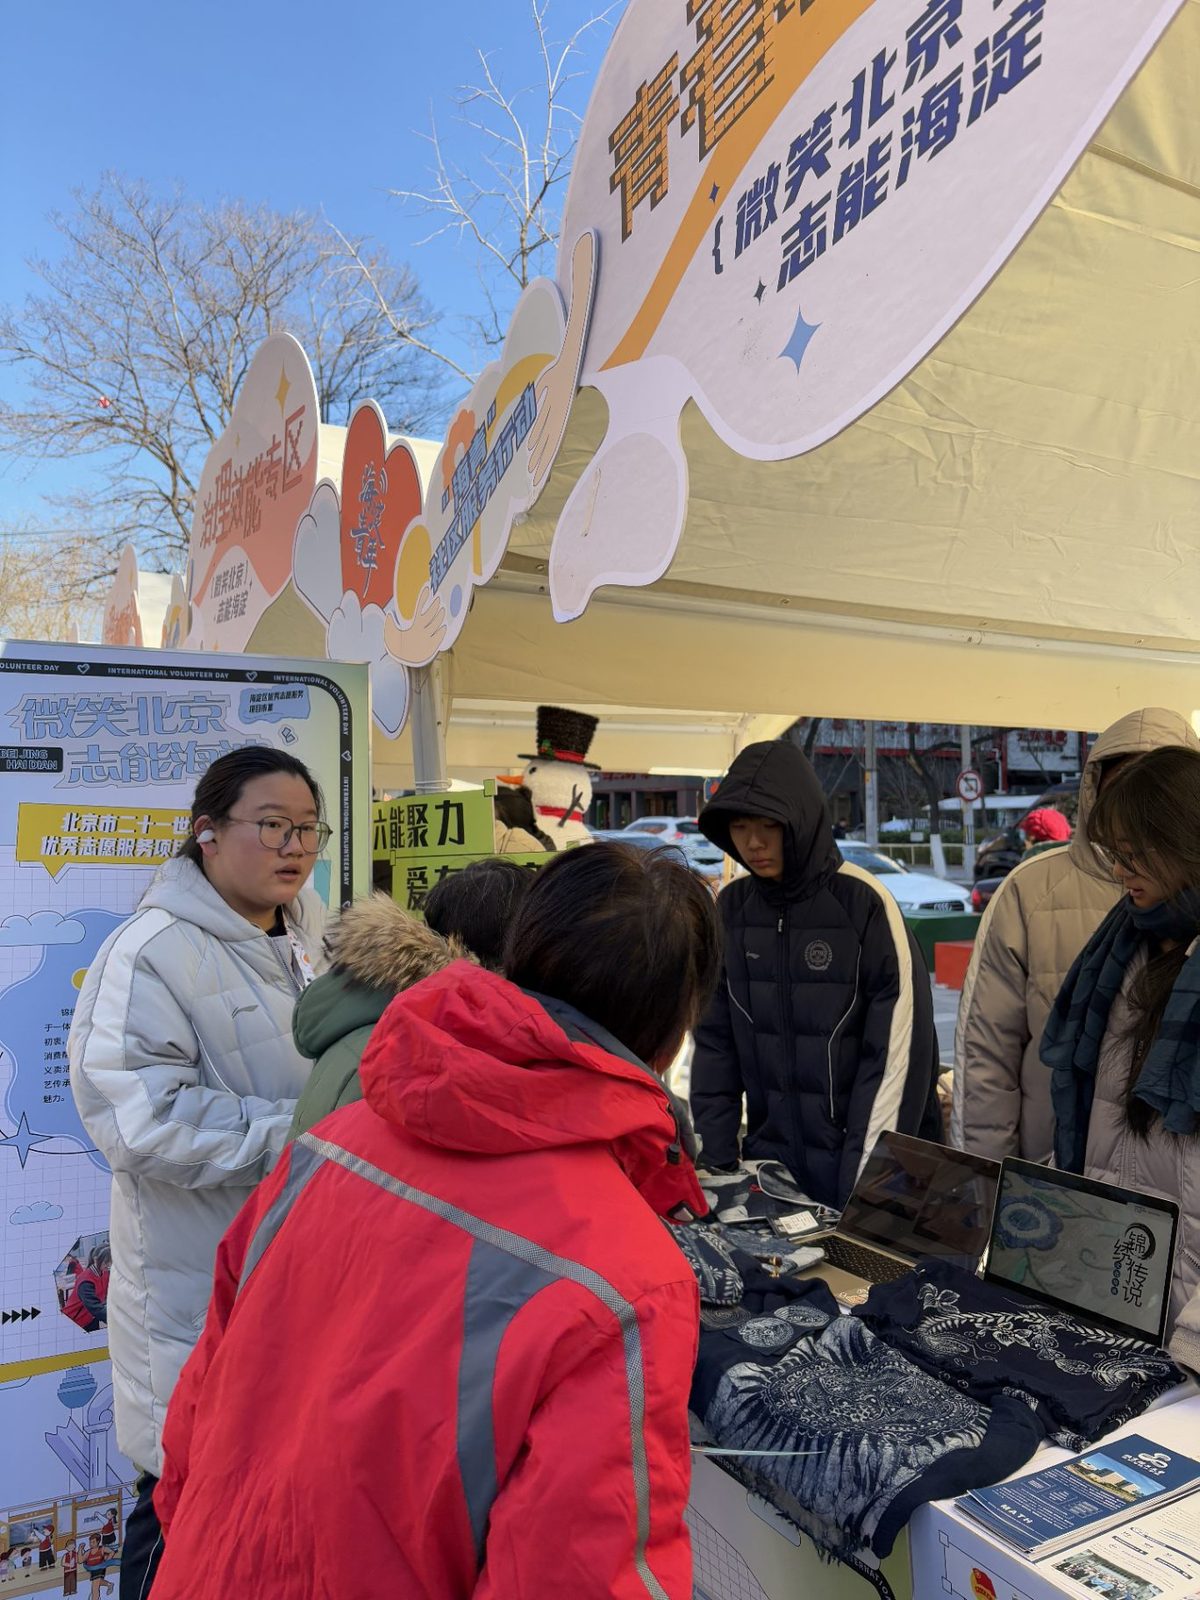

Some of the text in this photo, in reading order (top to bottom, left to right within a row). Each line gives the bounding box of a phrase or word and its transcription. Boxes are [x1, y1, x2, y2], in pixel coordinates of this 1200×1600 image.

[776, 0, 1048, 293] 志能海淀
[200, 405, 306, 549] 治理效能专区
[430, 382, 538, 595] 社区服务行动
[107, 667, 168, 676] INTERNATIONAL
[169, 670, 212, 679] VOLUNTEER
[21, 695, 226, 740] 微笑北京
[273, 674, 328, 687] INTERNATIONAL
[329, 683, 350, 720] VOLUNTEER
[6, 759, 58, 770] HAI DIAN
[19, 748, 48, 760] JING
[66, 739, 258, 783] 志能海
[373, 799, 465, 850] 六能聚力
[1000, 1504, 1033, 1524] MATH
